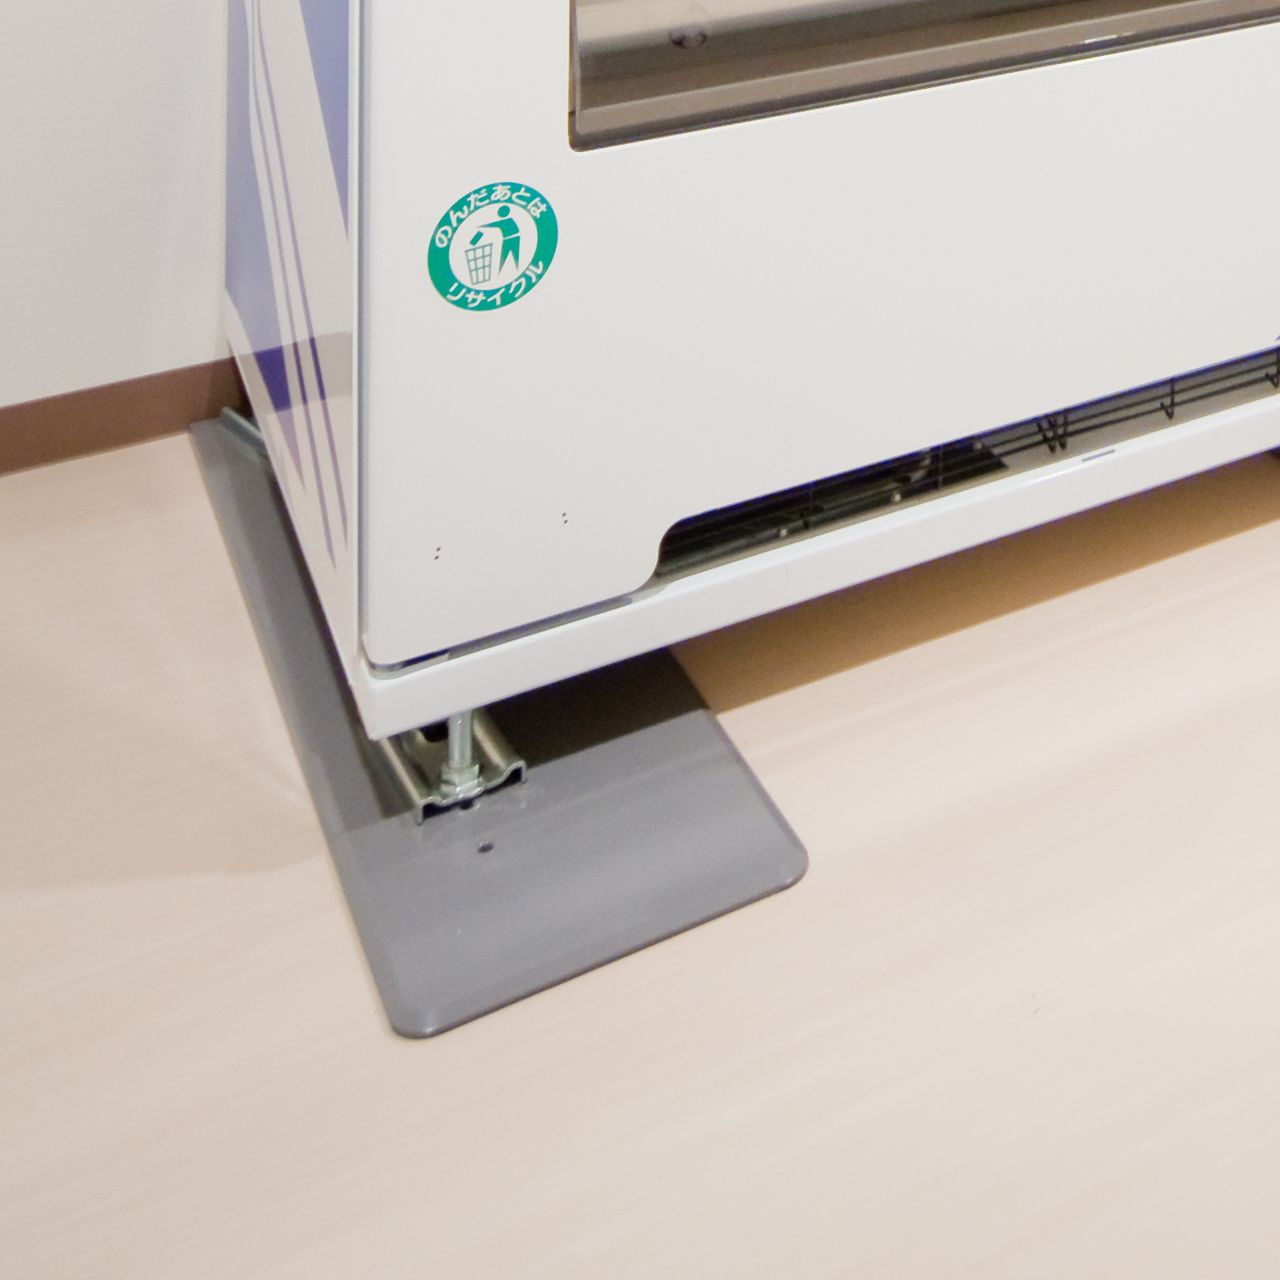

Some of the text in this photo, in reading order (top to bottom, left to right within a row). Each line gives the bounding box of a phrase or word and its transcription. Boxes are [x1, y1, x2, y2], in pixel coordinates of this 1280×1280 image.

[435, 183, 548, 249] のんだあとは
[446, 260, 544, 308] リサイクル
